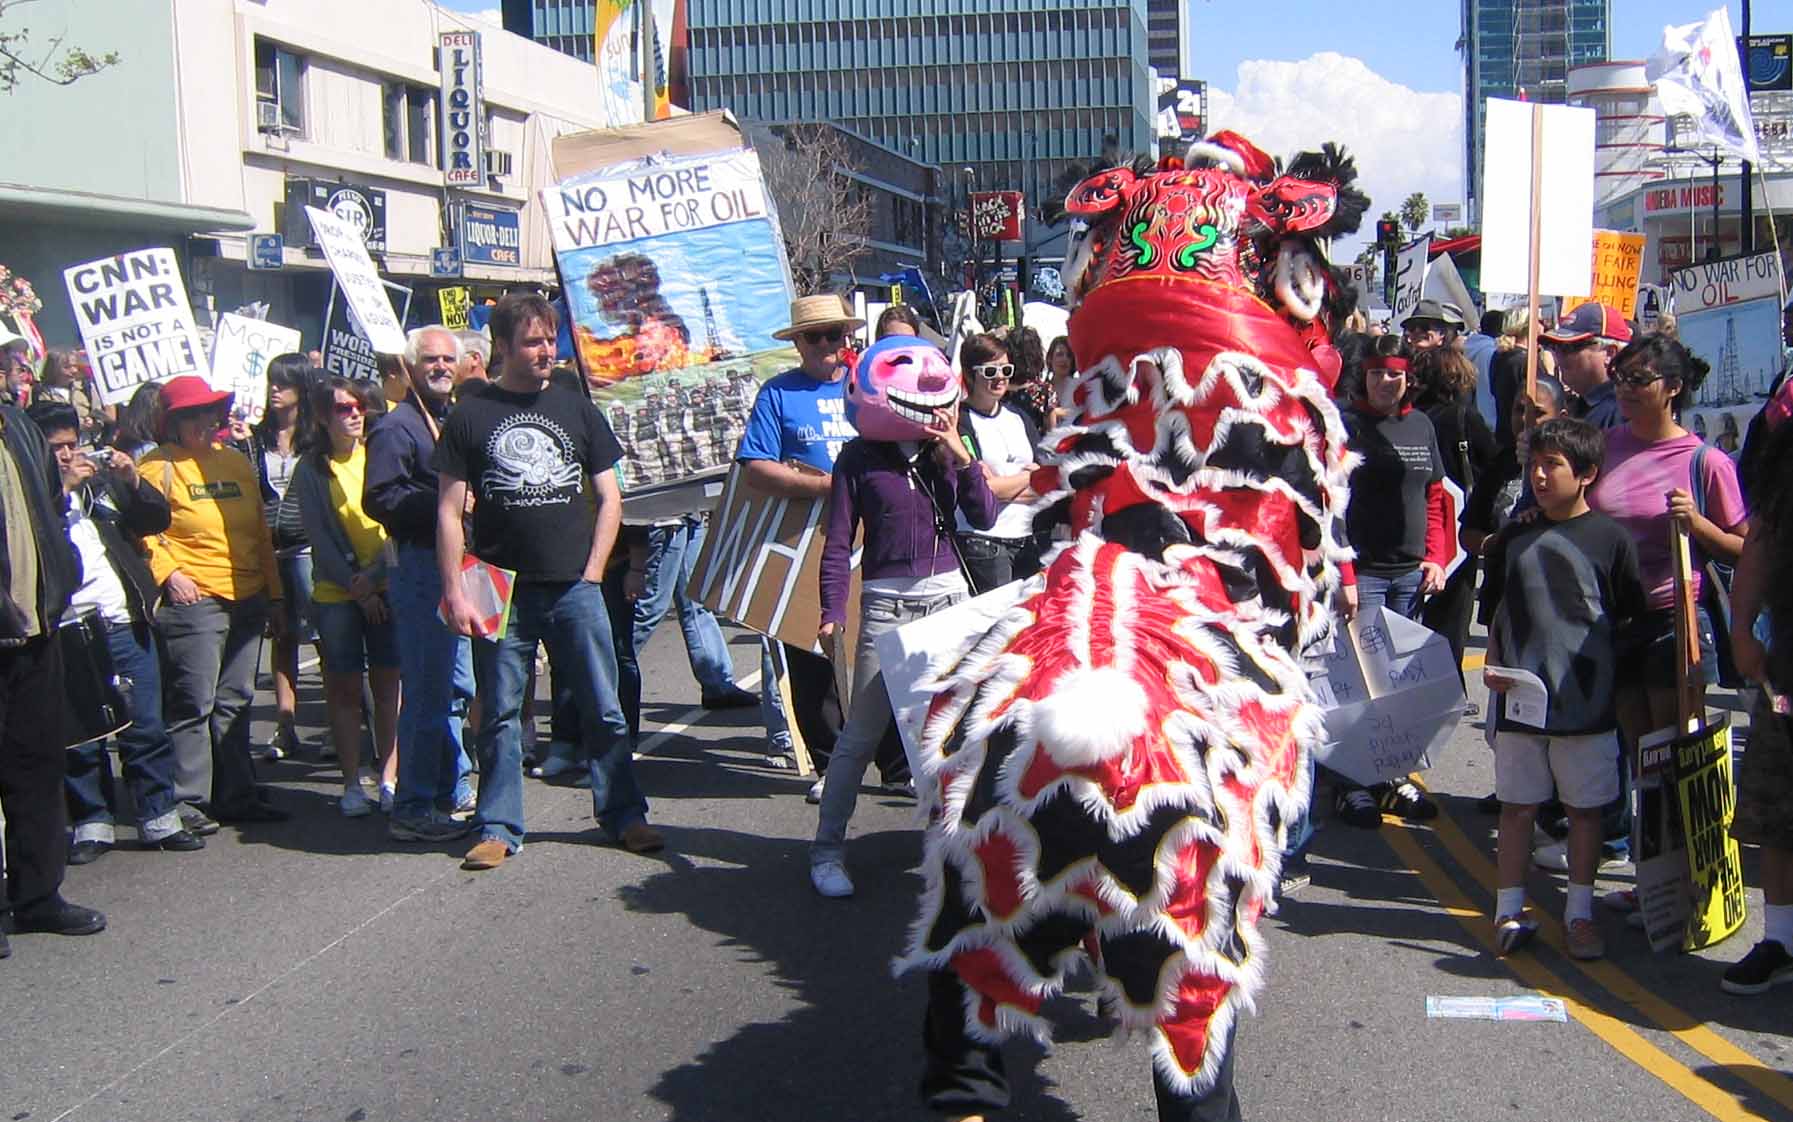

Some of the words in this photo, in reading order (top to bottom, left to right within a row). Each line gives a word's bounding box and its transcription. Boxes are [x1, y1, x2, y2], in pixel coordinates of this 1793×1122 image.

[443, 35, 472, 46] DELI
[450, 49, 472, 169] LIQUOR
[1177, 89, 1201, 116] 21
[447, 170, 478, 182] CAFE
[560, 186, 607, 217] NO
[627, 165, 712, 204] MORE
[1680, 183, 1725, 207] MUSIC
[335, 208, 364, 227] SIR
[564, 207, 650, 246] WAR
[660, 198, 704, 231] FOR
[711, 189, 761, 221] OIL
[466, 221, 497, 247] LIQUOR
[499, 226, 518, 248] DELI
[491, 249, 516, 262] CAFE
[1604, 253, 1636, 272] FAIR
[73, 254, 170, 294] CNN:
[1592, 270, 1636, 290] ILLING
[1670, 269, 1697, 294] NO
[1704, 260, 1740, 284] WAR
[1745, 254, 1780, 280] FOR
[80, 283, 177, 326] WAR
[1702, 280, 1739, 306] OIL
[94, 335, 114, 351] IS
[121, 321, 163, 343] NOT
[173, 318, 185, 331] A
[98, 336, 196, 392] GAME
[1687, 760, 1734, 837] NOW
[1693, 825, 1724, 873] WAR
